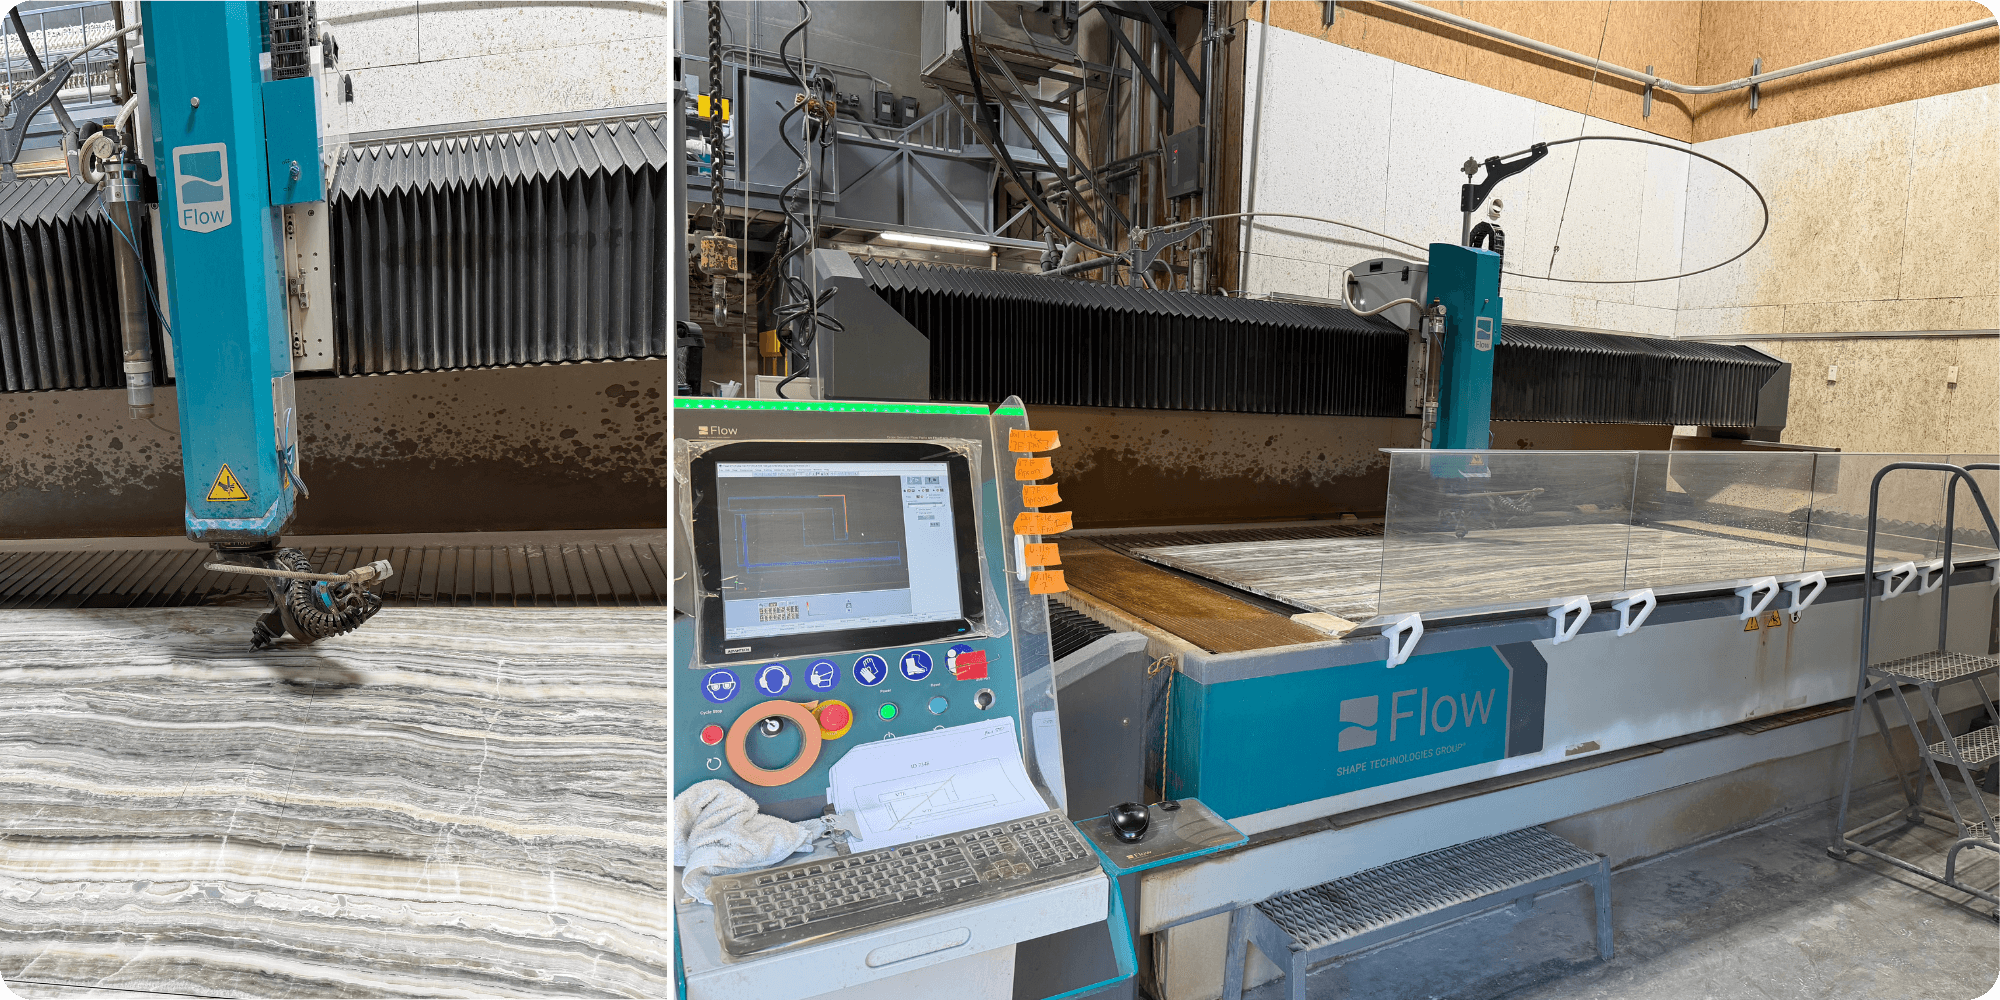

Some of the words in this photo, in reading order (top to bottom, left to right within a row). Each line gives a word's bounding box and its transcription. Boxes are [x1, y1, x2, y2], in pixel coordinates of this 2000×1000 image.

[183, 208, 225, 226] Flow
[1476, 340, 1490, 349] Flow
[710, 425, 738, 436] Flow
[1389, 686, 1496, 742] Flow
[1336, 762, 1367, 777] SHAPE
[1370, 748, 1433, 770] TECHNOLOGIES
